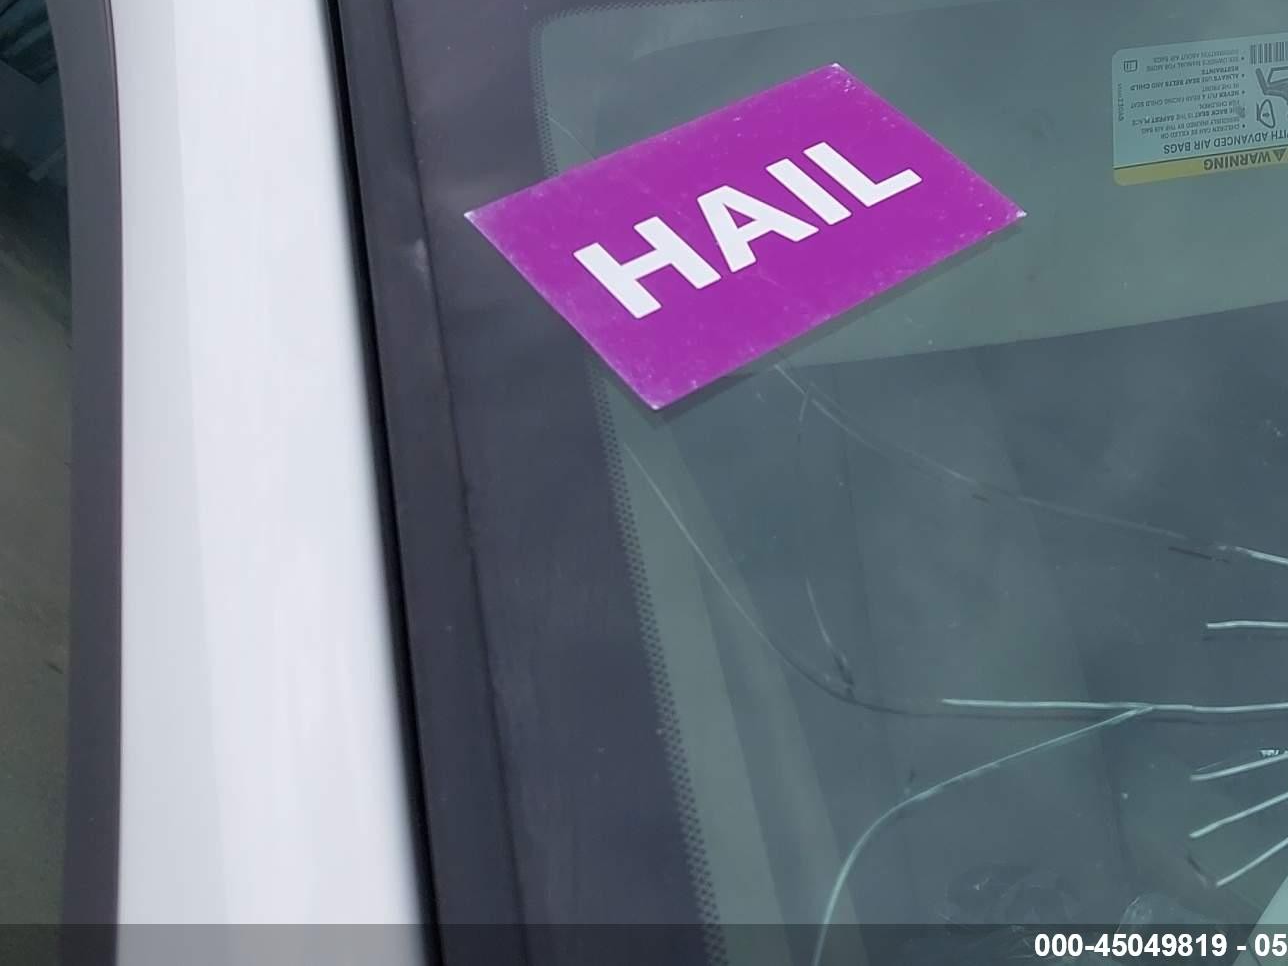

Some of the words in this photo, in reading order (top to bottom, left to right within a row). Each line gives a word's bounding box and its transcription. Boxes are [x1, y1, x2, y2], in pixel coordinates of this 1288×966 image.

[1130, 84, 1151, 92] CHILD
[1195, 140, 1211, 151] AIR
[1215, 132, 1268, 148] ADVANCED
[1164, 143, 1191, 155] BAGS
[1204, 151, 1271, 171] WARNING
[573, 141, 923, 320] HAIL
